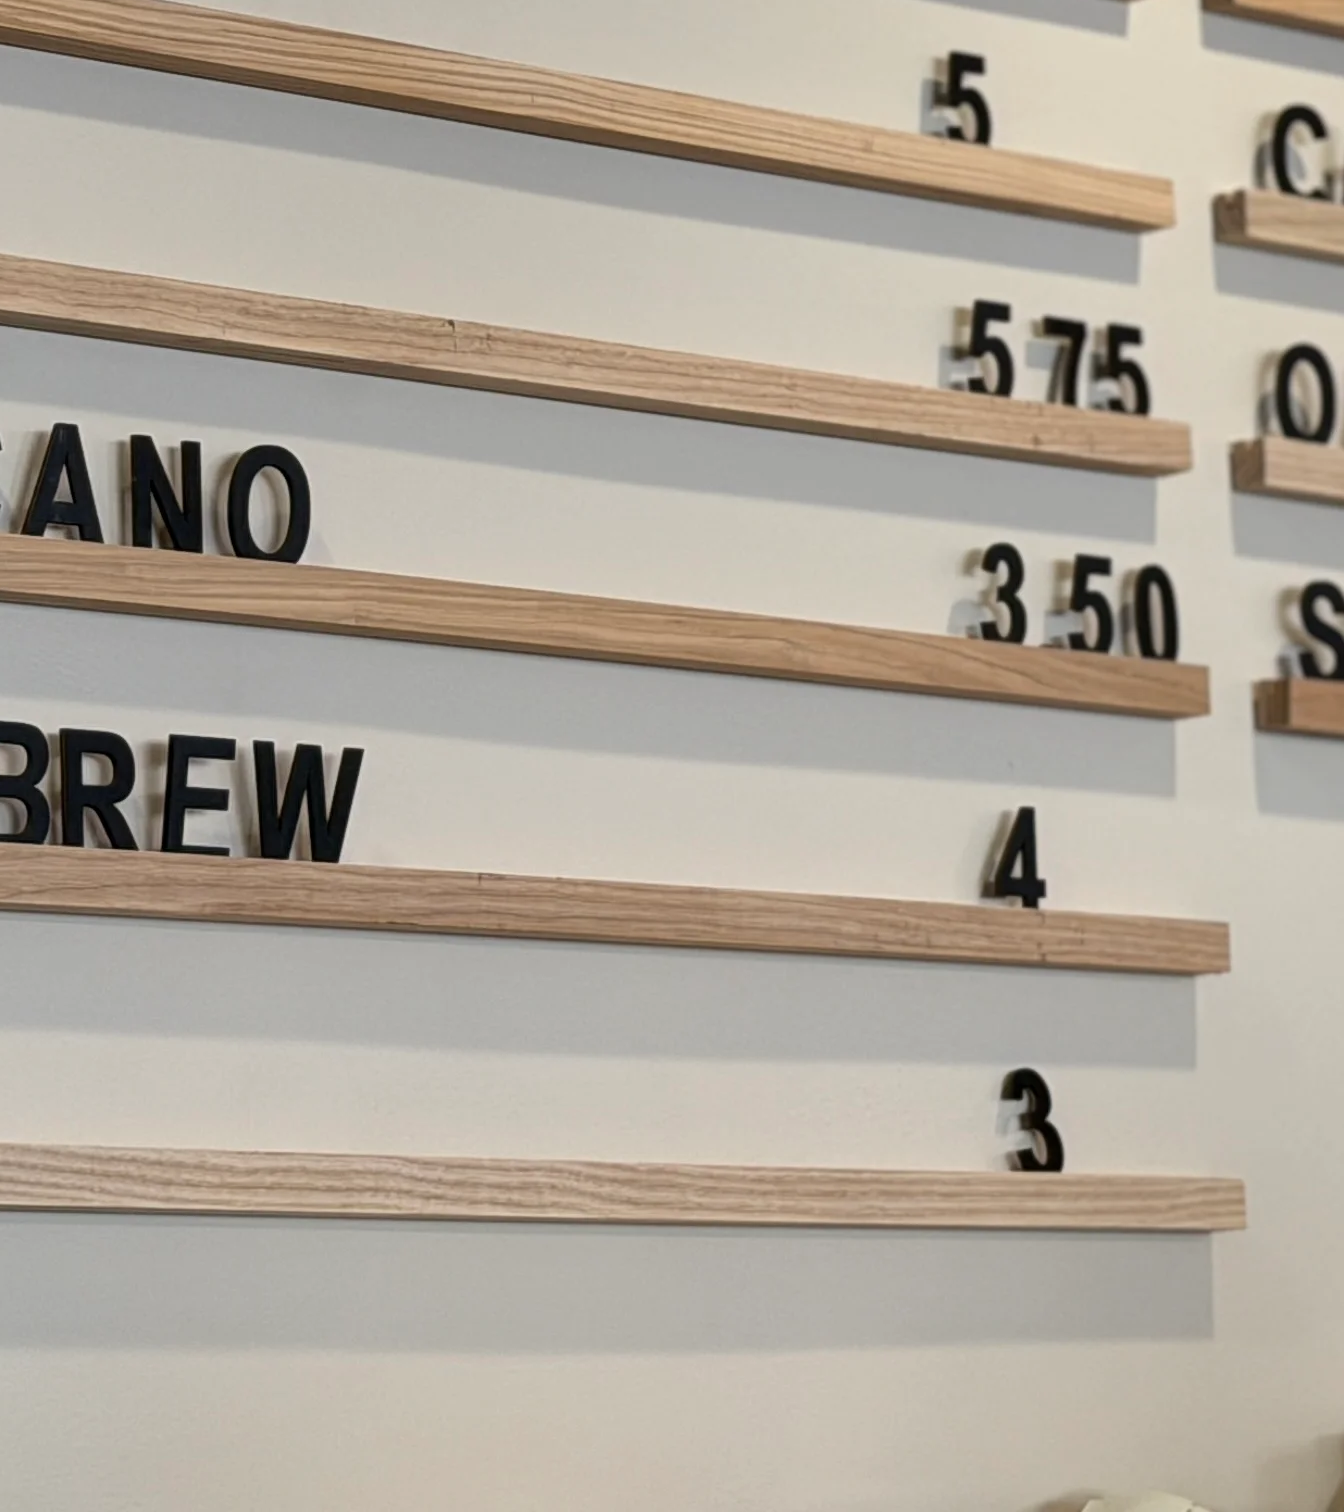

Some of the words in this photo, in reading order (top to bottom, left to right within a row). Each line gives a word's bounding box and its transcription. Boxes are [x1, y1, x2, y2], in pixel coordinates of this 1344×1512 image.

[943, 52, 991, 146] 5
[989, 807, 1046, 910] 4
[1001, 1068, 1065, 1173] 3
